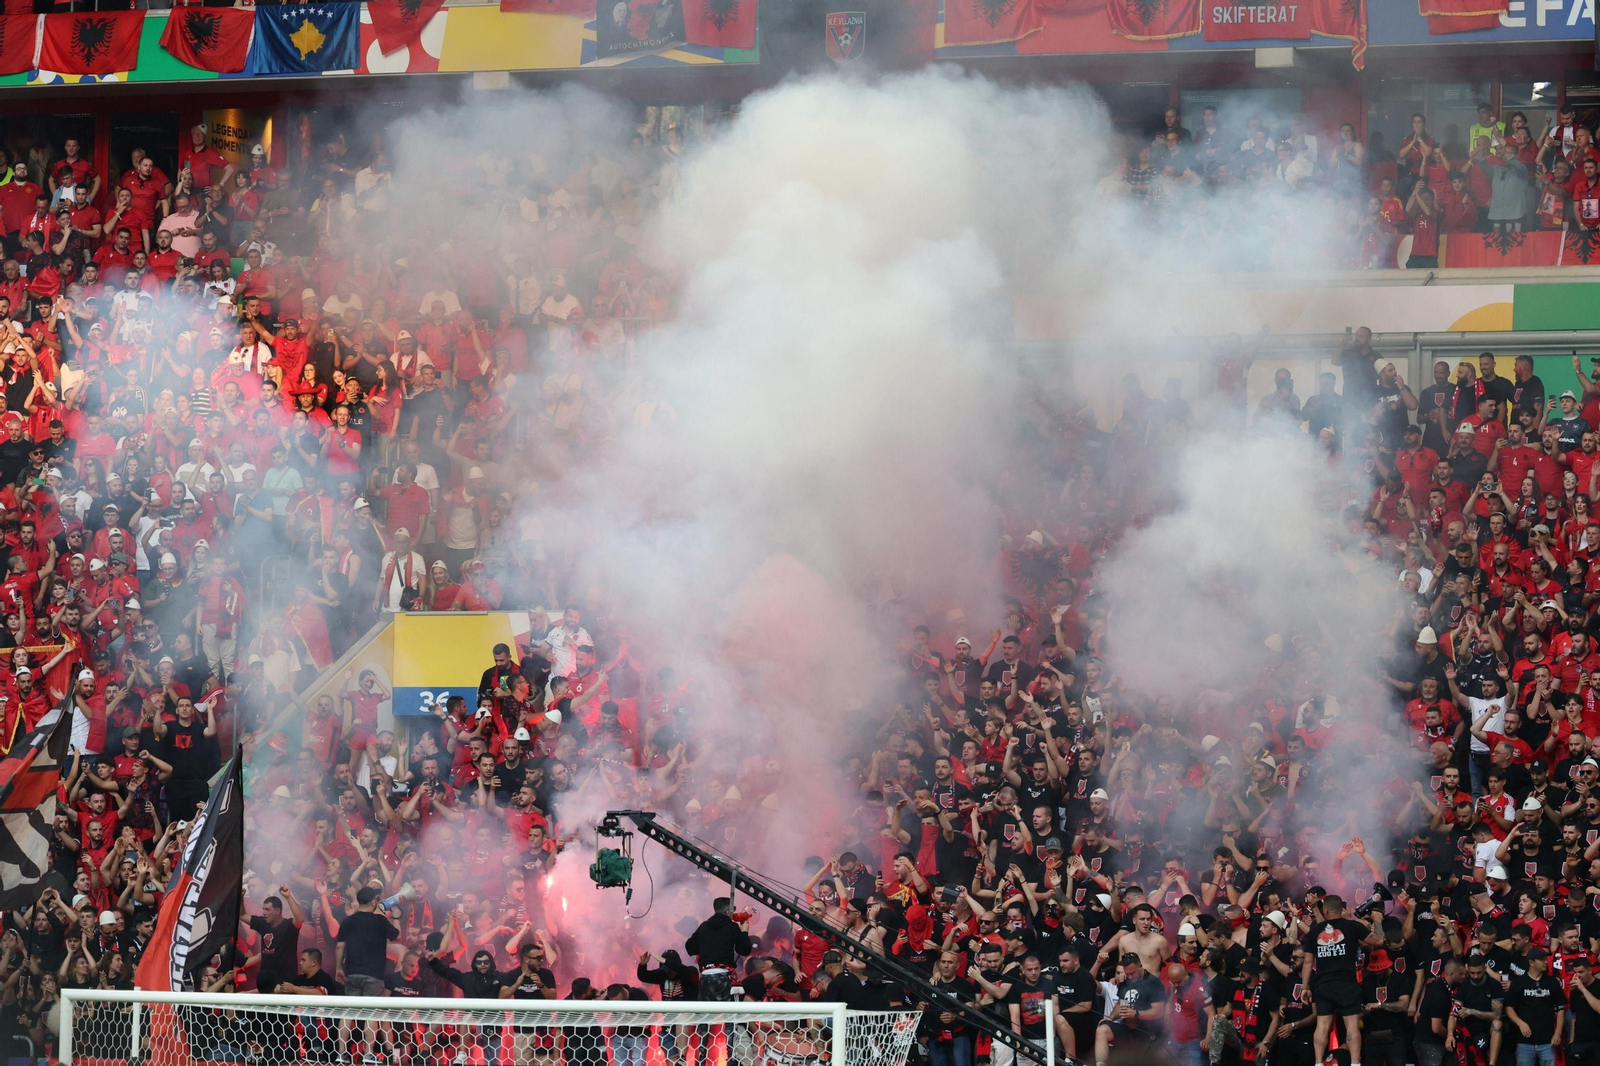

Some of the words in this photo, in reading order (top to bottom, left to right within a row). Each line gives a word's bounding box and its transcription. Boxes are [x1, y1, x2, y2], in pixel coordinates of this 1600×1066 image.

[1212, 5, 1297, 24] SKIFTERAT
[211, 122, 253, 141] LEGENDA
[576, 683, 583, 693] 6
[419, 691, 449, 712] 36
